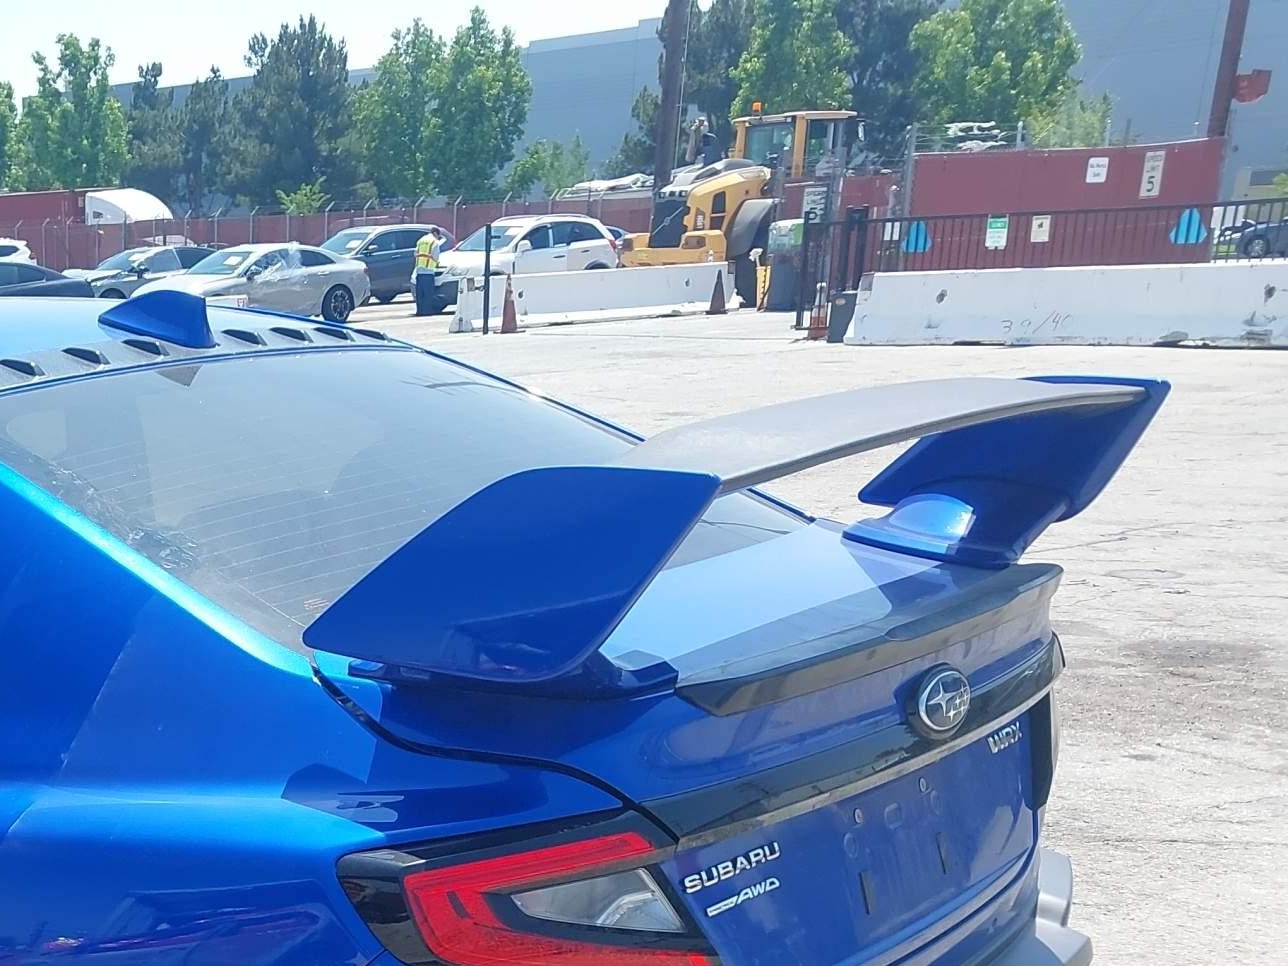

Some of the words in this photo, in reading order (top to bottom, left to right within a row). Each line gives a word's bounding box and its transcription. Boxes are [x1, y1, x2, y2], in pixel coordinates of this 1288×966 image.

[1145, 175, 1156, 193] 5
[987, 721, 1022, 754] WRX
[684, 842, 780, 893] SUBARU
[737, 877, 780, 904] AWD
